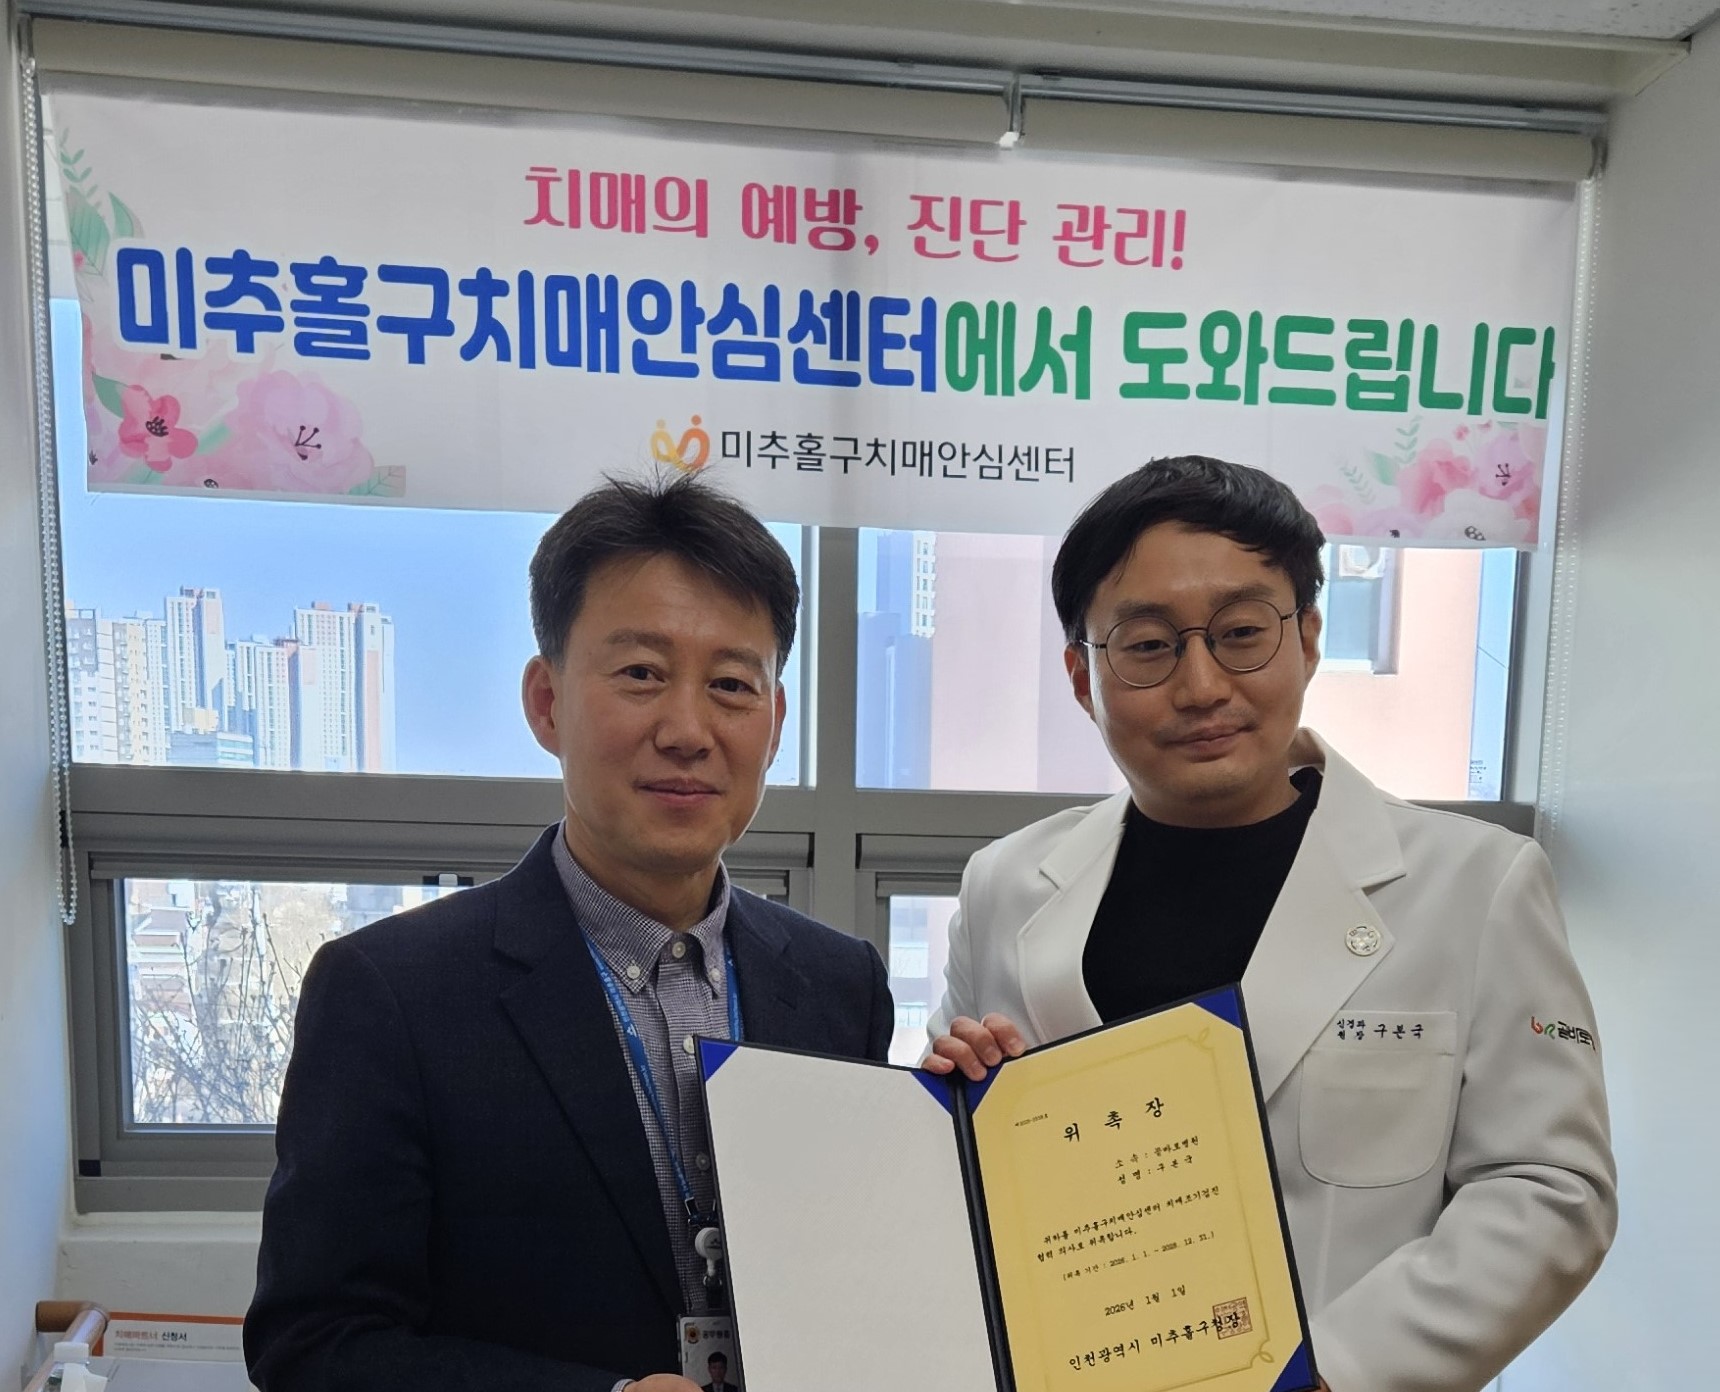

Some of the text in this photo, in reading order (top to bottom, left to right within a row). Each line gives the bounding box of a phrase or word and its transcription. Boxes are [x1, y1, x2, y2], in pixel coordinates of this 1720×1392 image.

[525, 166, 1186, 270] 치매의 예방, 진단 관리!
[116, 247, 1555, 419] 미추홀구치매안심센터에서 도와드립니다
[721, 430, 1074, 482] 미추홀구치매안심센터
[1104, 1285, 1186, 1316] 2026년 1월 1일
[161, 1331, 187, 1341] 신청서
[1069, 1339, 1141, 1371] 인천광역시
[1150, 1311, 1241, 1348] 미추홀구청장
